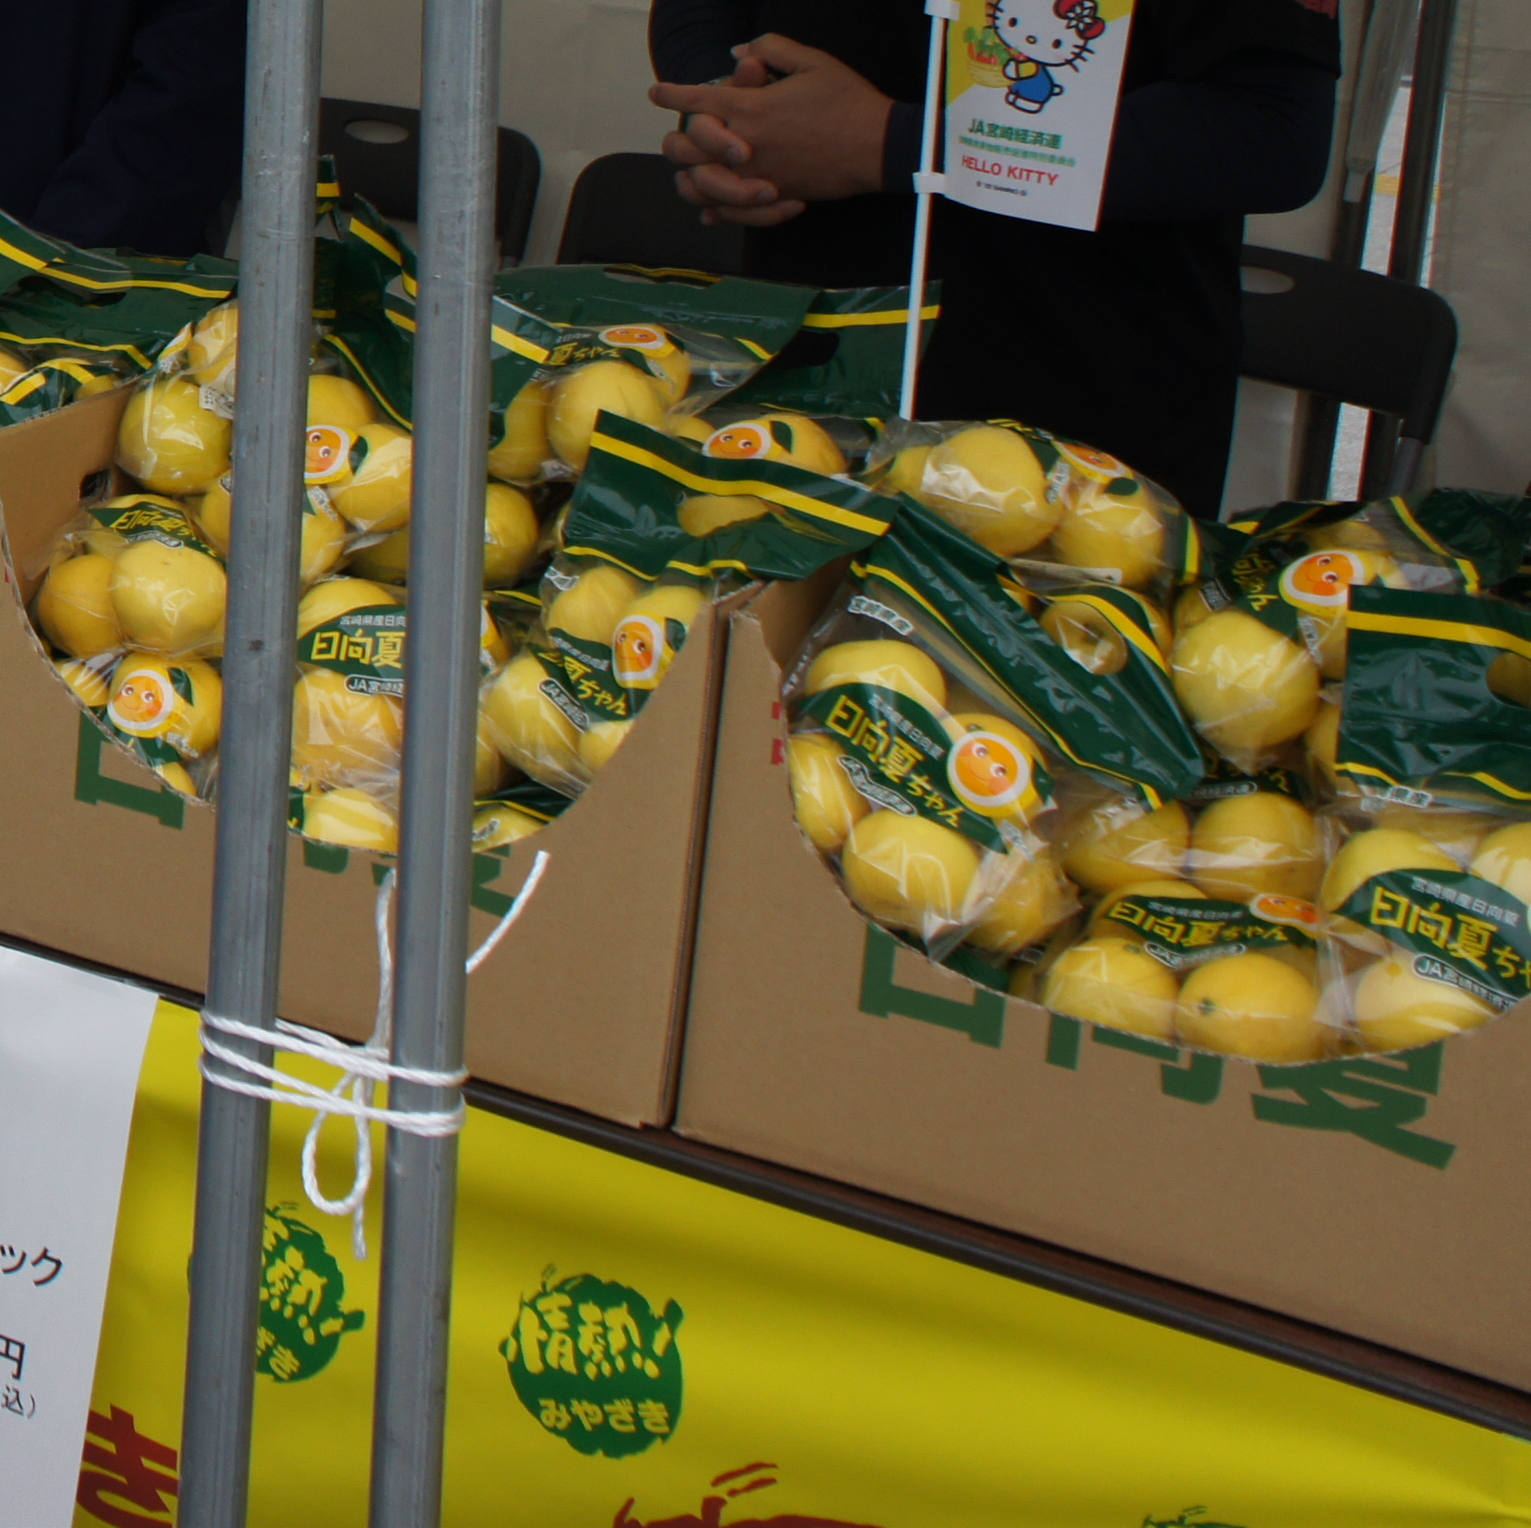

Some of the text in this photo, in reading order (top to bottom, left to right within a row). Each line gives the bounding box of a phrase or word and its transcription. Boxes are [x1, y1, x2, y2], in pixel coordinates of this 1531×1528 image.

[962, 155, 1060, 186] HELLO KITTY
[310, 628, 408, 670] 日向夏
[824, 693, 966, 829] 日向夏ちゃん
[538, 1396, 671, 1437] みやざき
